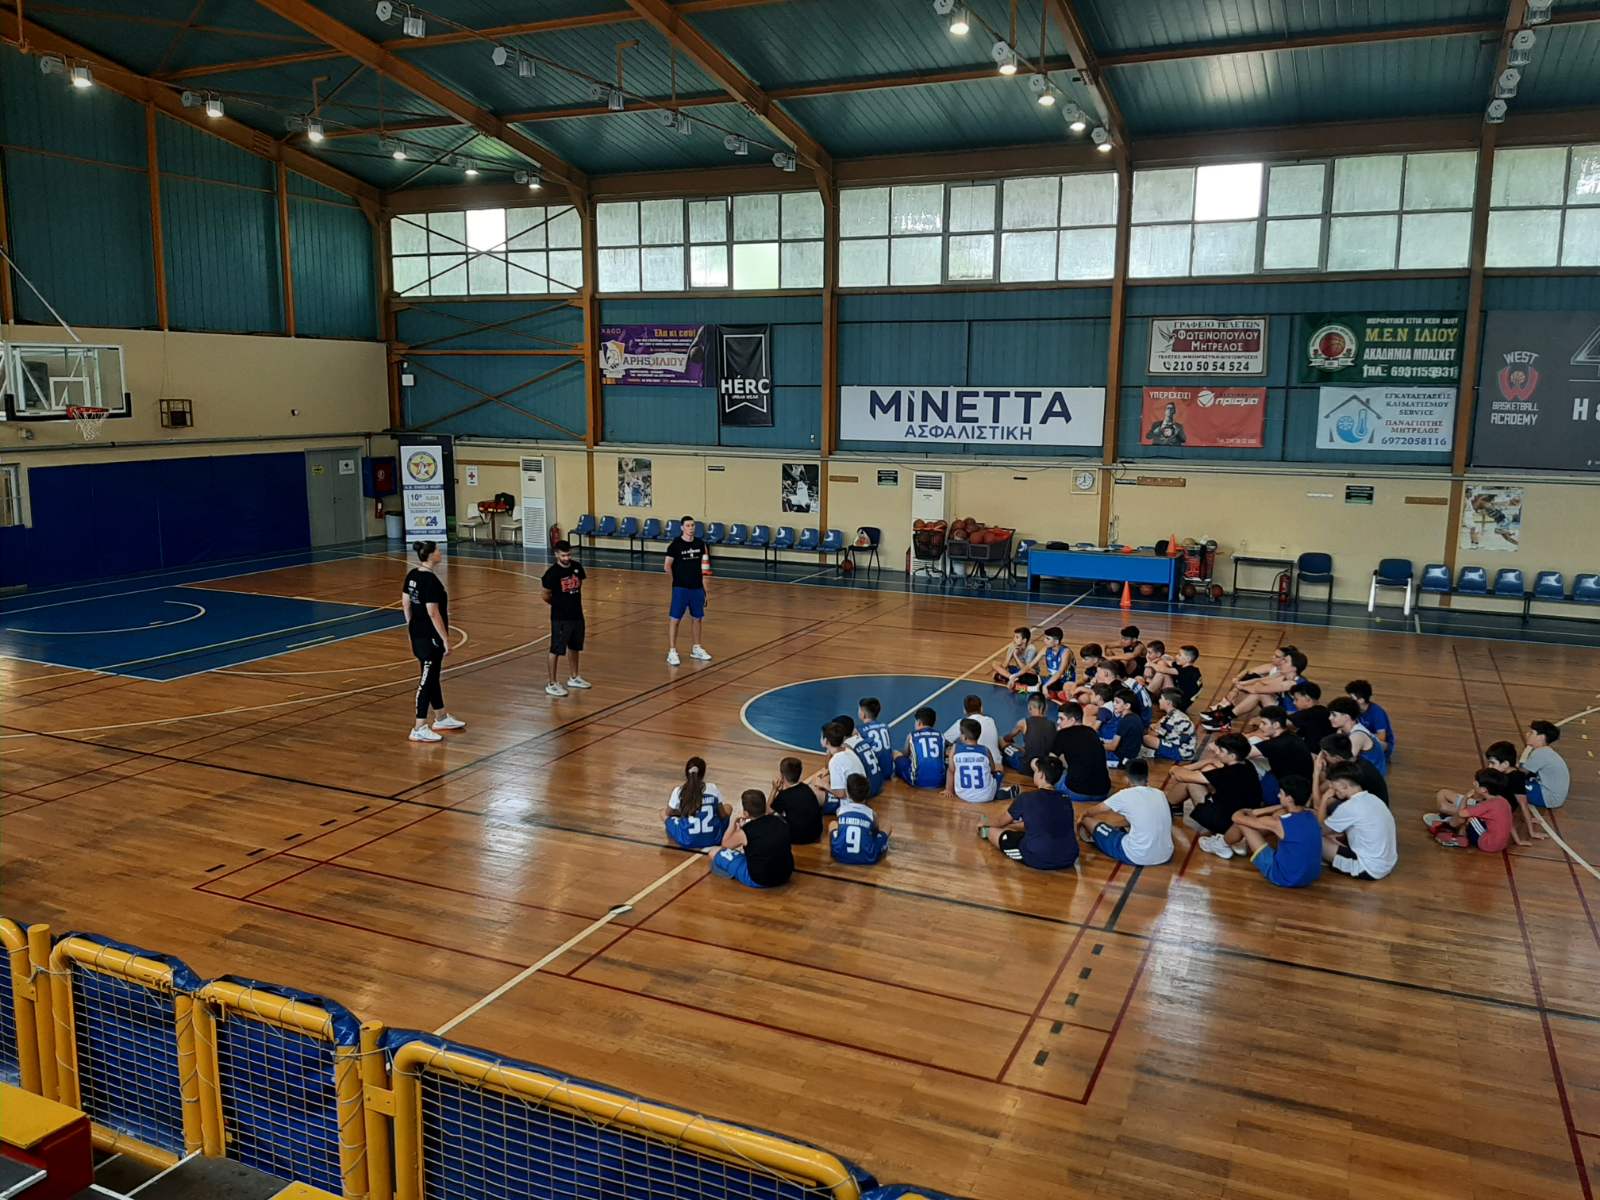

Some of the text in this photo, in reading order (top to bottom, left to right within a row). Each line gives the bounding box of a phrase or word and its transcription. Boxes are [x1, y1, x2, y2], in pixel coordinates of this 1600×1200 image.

[1177, 330, 1260, 340] ΦΩΤΕΙΝΟΠΟΥΛΟΥ
[1414, 328, 1458, 342] ΙΛΙΟΥ
[1191, 341, 1244, 351] ΜΗΤΡΕΛΟΣ
[1363, 348, 1457, 361] ΑΚΑΔΗΜΙΑ ΜΠΑΣΚΕΤ
[1503, 351, 1540, 365] WEST
[1172, 361, 1250, 371] 210 50 54 524
[721, 375, 770, 394] HÉRC
[1492, 401, 1539, 411] BASKETBALL
[1572, 398, 1589, 421] H
[1491, 413, 1538, 426] ACADEMY
[904, 424, 1033, 441] ΑΣΦΑΛΙΣΤΙΚΗ
[1381, 437, 1447, 446] 6972058116
[868, 728, 891, 752] 30
[919, 737, 940, 758] 15
[960, 765, 985, 790] 63
[846, 825, 861, 854] 9
